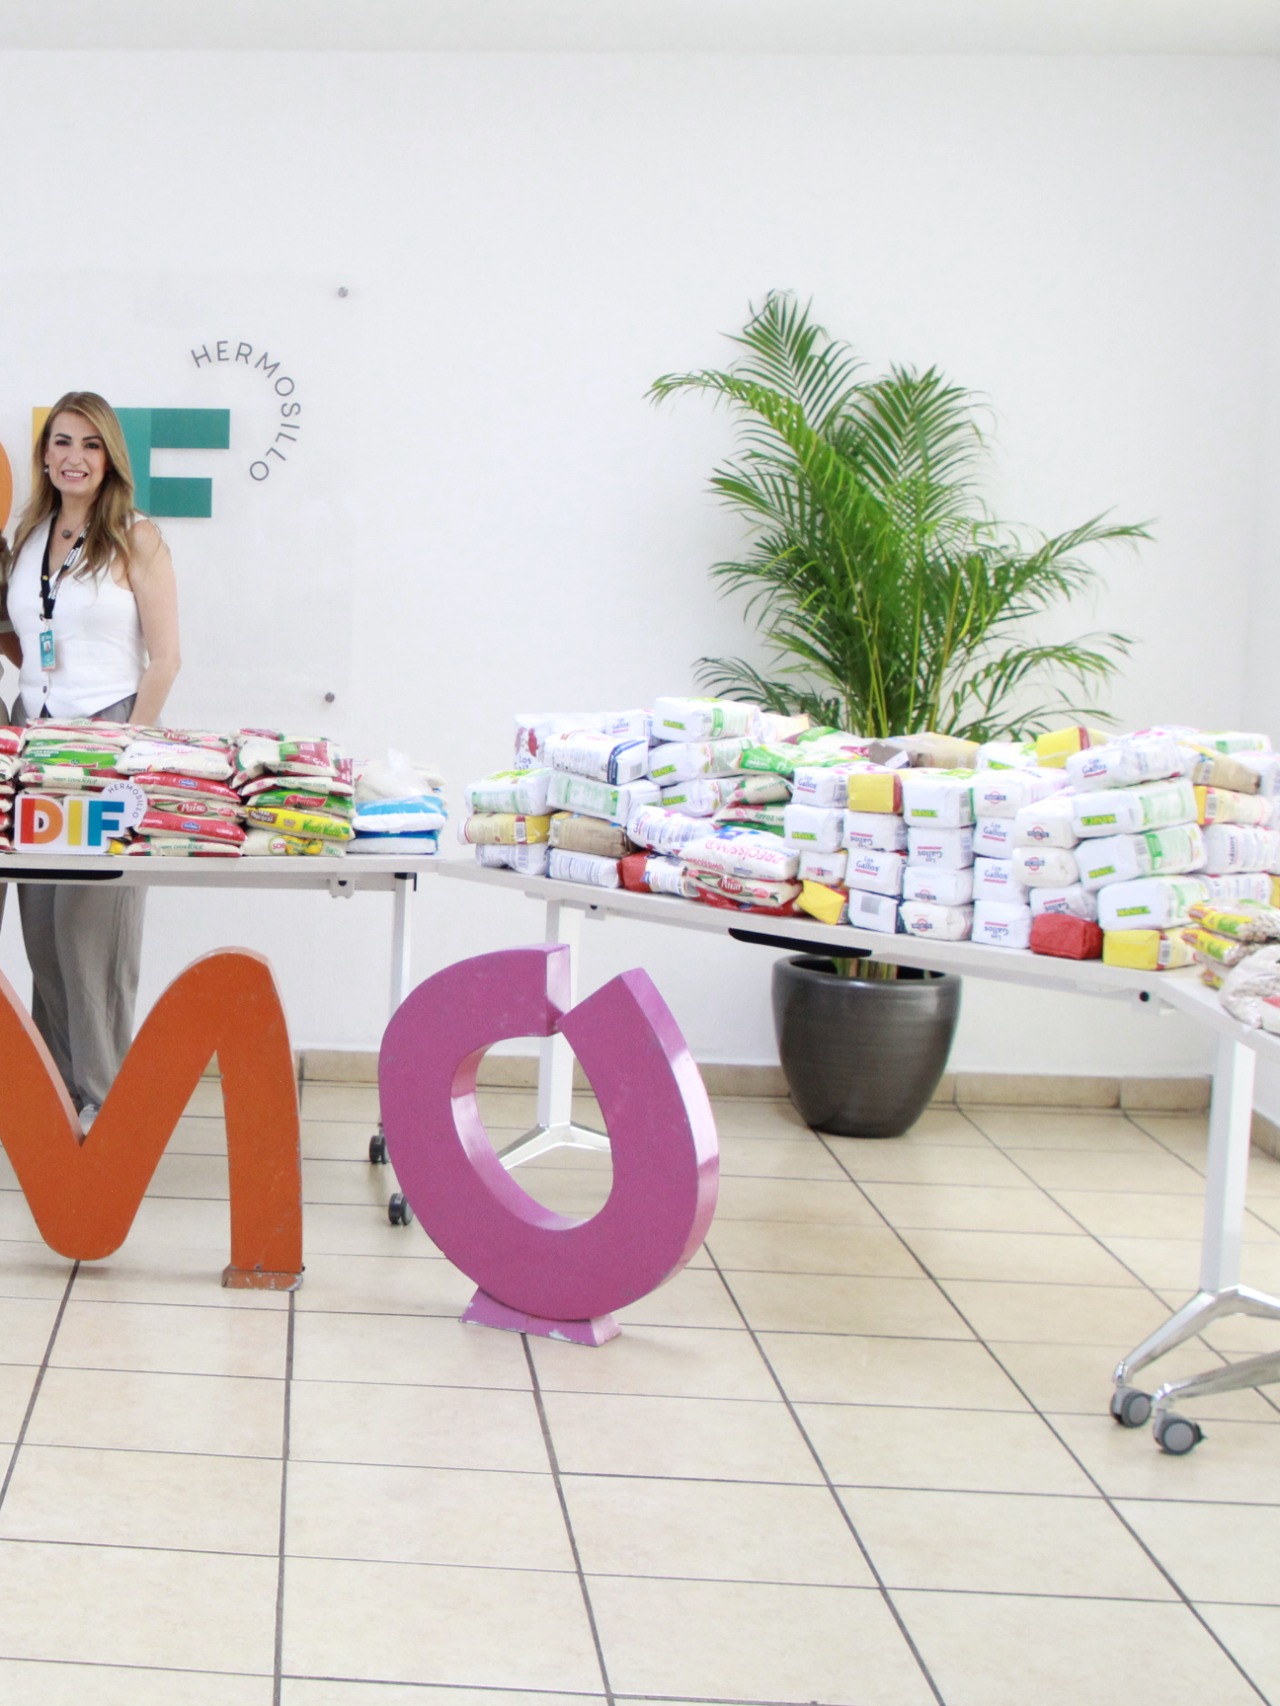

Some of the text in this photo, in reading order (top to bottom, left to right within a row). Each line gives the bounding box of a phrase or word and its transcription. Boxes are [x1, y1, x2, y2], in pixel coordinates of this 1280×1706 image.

[190, 340, 301, 481] HERMOSILLO
[107, 782, 143, 818] HERMOSILLO
[20, 798, 124, 846] DIF
[982, 827, 1008, 838] Gallos
[856, 860, 880, 872] Gallos
[984, 870, 1008, 880] Gallos
[984, 926, 1009, 936] Gallos
